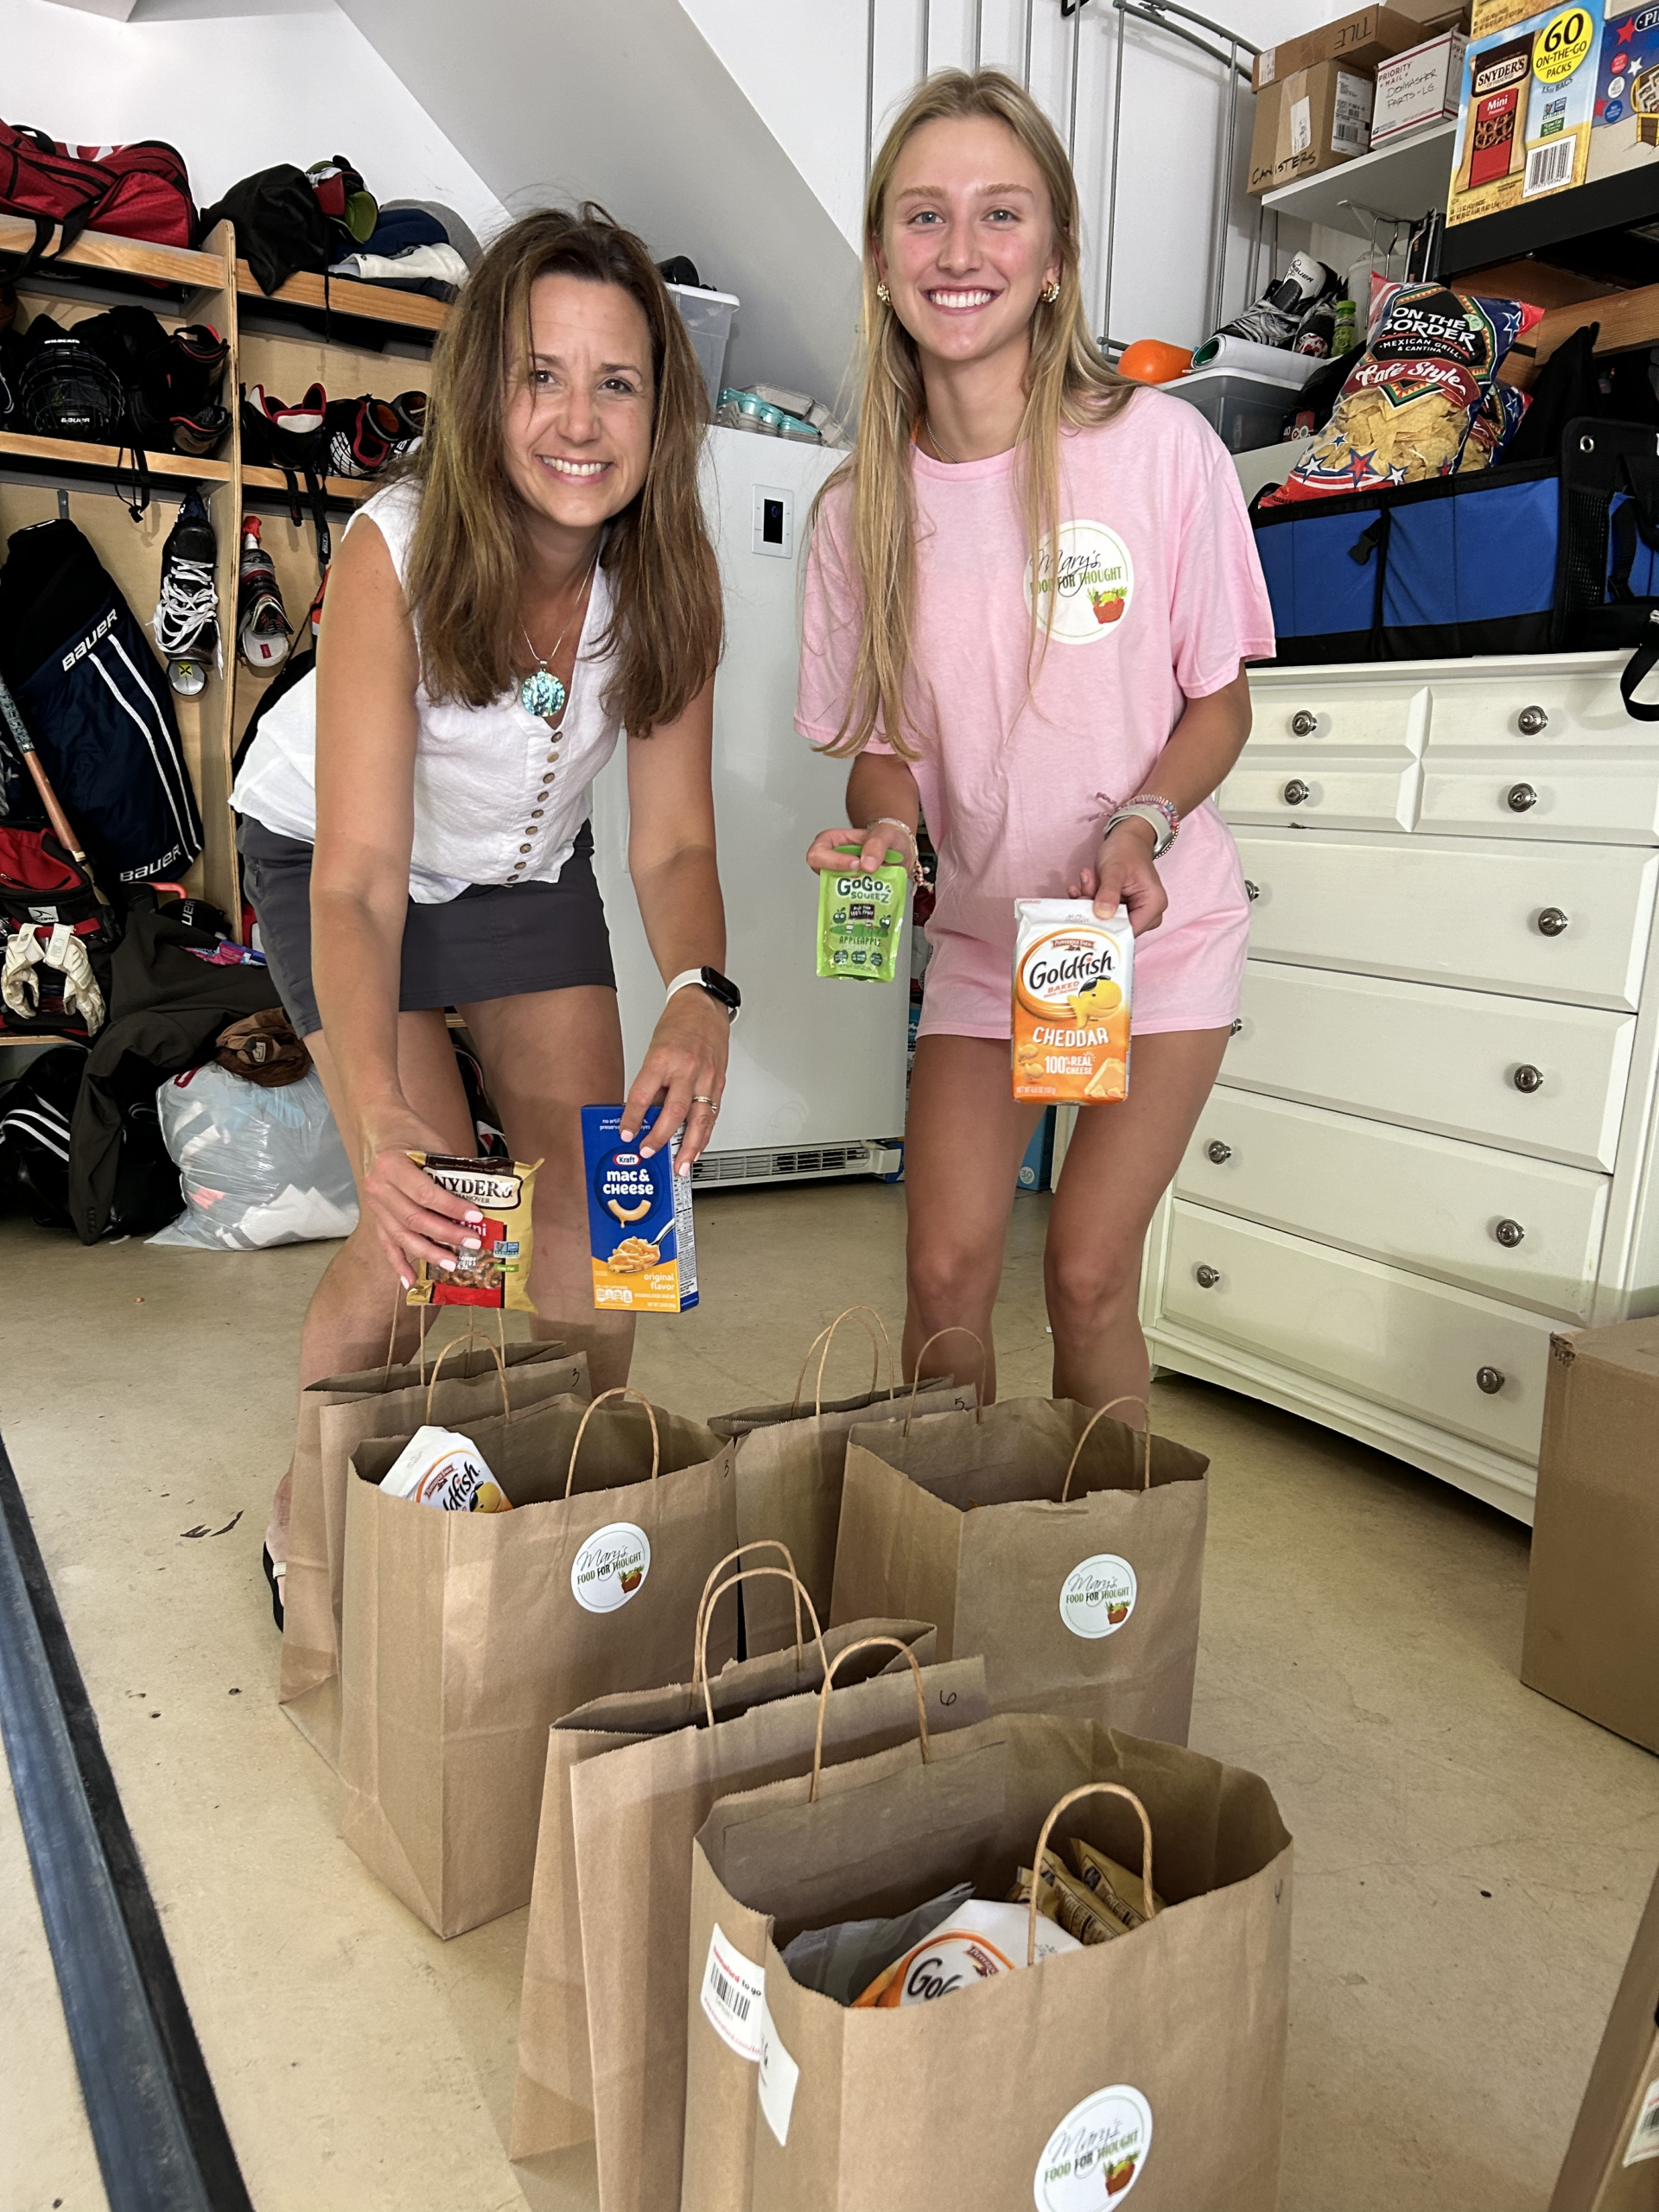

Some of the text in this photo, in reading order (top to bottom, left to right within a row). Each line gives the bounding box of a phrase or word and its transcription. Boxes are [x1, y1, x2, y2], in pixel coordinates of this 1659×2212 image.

[1544, 13, 1584, 52] 60
[1535, 41, 1587, 68] ON-THE-GO
[1378, 60, 1413, 82] PRIORITY
[1478, 58, 1525, 86] SNYDER'S
[1546, 61, 1572, 79] PACKS
[1385, 76, 1402, 86] MAIL
[1556, 77, 1573, 93] BAGS
[1487, 94, 1508, 111] Mini
[1252, 150, 1316, 185] CANISTERS
[1392, 307, 1466, 330] ON THE
[1383, 338, 1459, 359] MEXICAN GRILL
[1355, 361, 1466, 397] Café Style
[1058, 574, 1075, 591] FOR
[1078, 566, 1122, 585] THOUGHT
[61, 608, 118, 671] BAUER
[120, 844, 182, 882] BAUER
[181, 900, 195, 925] UER
[1029, 950, 1112, 989] Goldfish
[1047, 981, 1080, 994] BAKED
[1033, 1026, 1109, 1047] CHEDDAR
[1065, 1066, 1093, 1075] CHEESE
[1071, 1055, 1093, 1066] REAL
[607, 1168, 650, 1182] mac &
[1021, 1170, 1033, 1179] 30
[644, 1273, 674, 1282] original
[651, 1281, 675, 1290] flavor
[572, 1368, 580, 1388] 3
[955, 1396, 964, 1411] 5
[576, 1545, 628, 1581] Mary's
[577, 1551, 641, 1585] FOOD FOR THOUGHT
[1066, 1586, 1129, 1604] FOOD FOR THOUGHT
[1068, 1573, 1118, 1607] Mary's
[939, 1690, 957, 1706] 6
[741, 1979, 750, 1990] to
[751, 1986, 761, 1998] go
[1045, 2126, 1140, 2183] FOOD FOR THOUGHT
